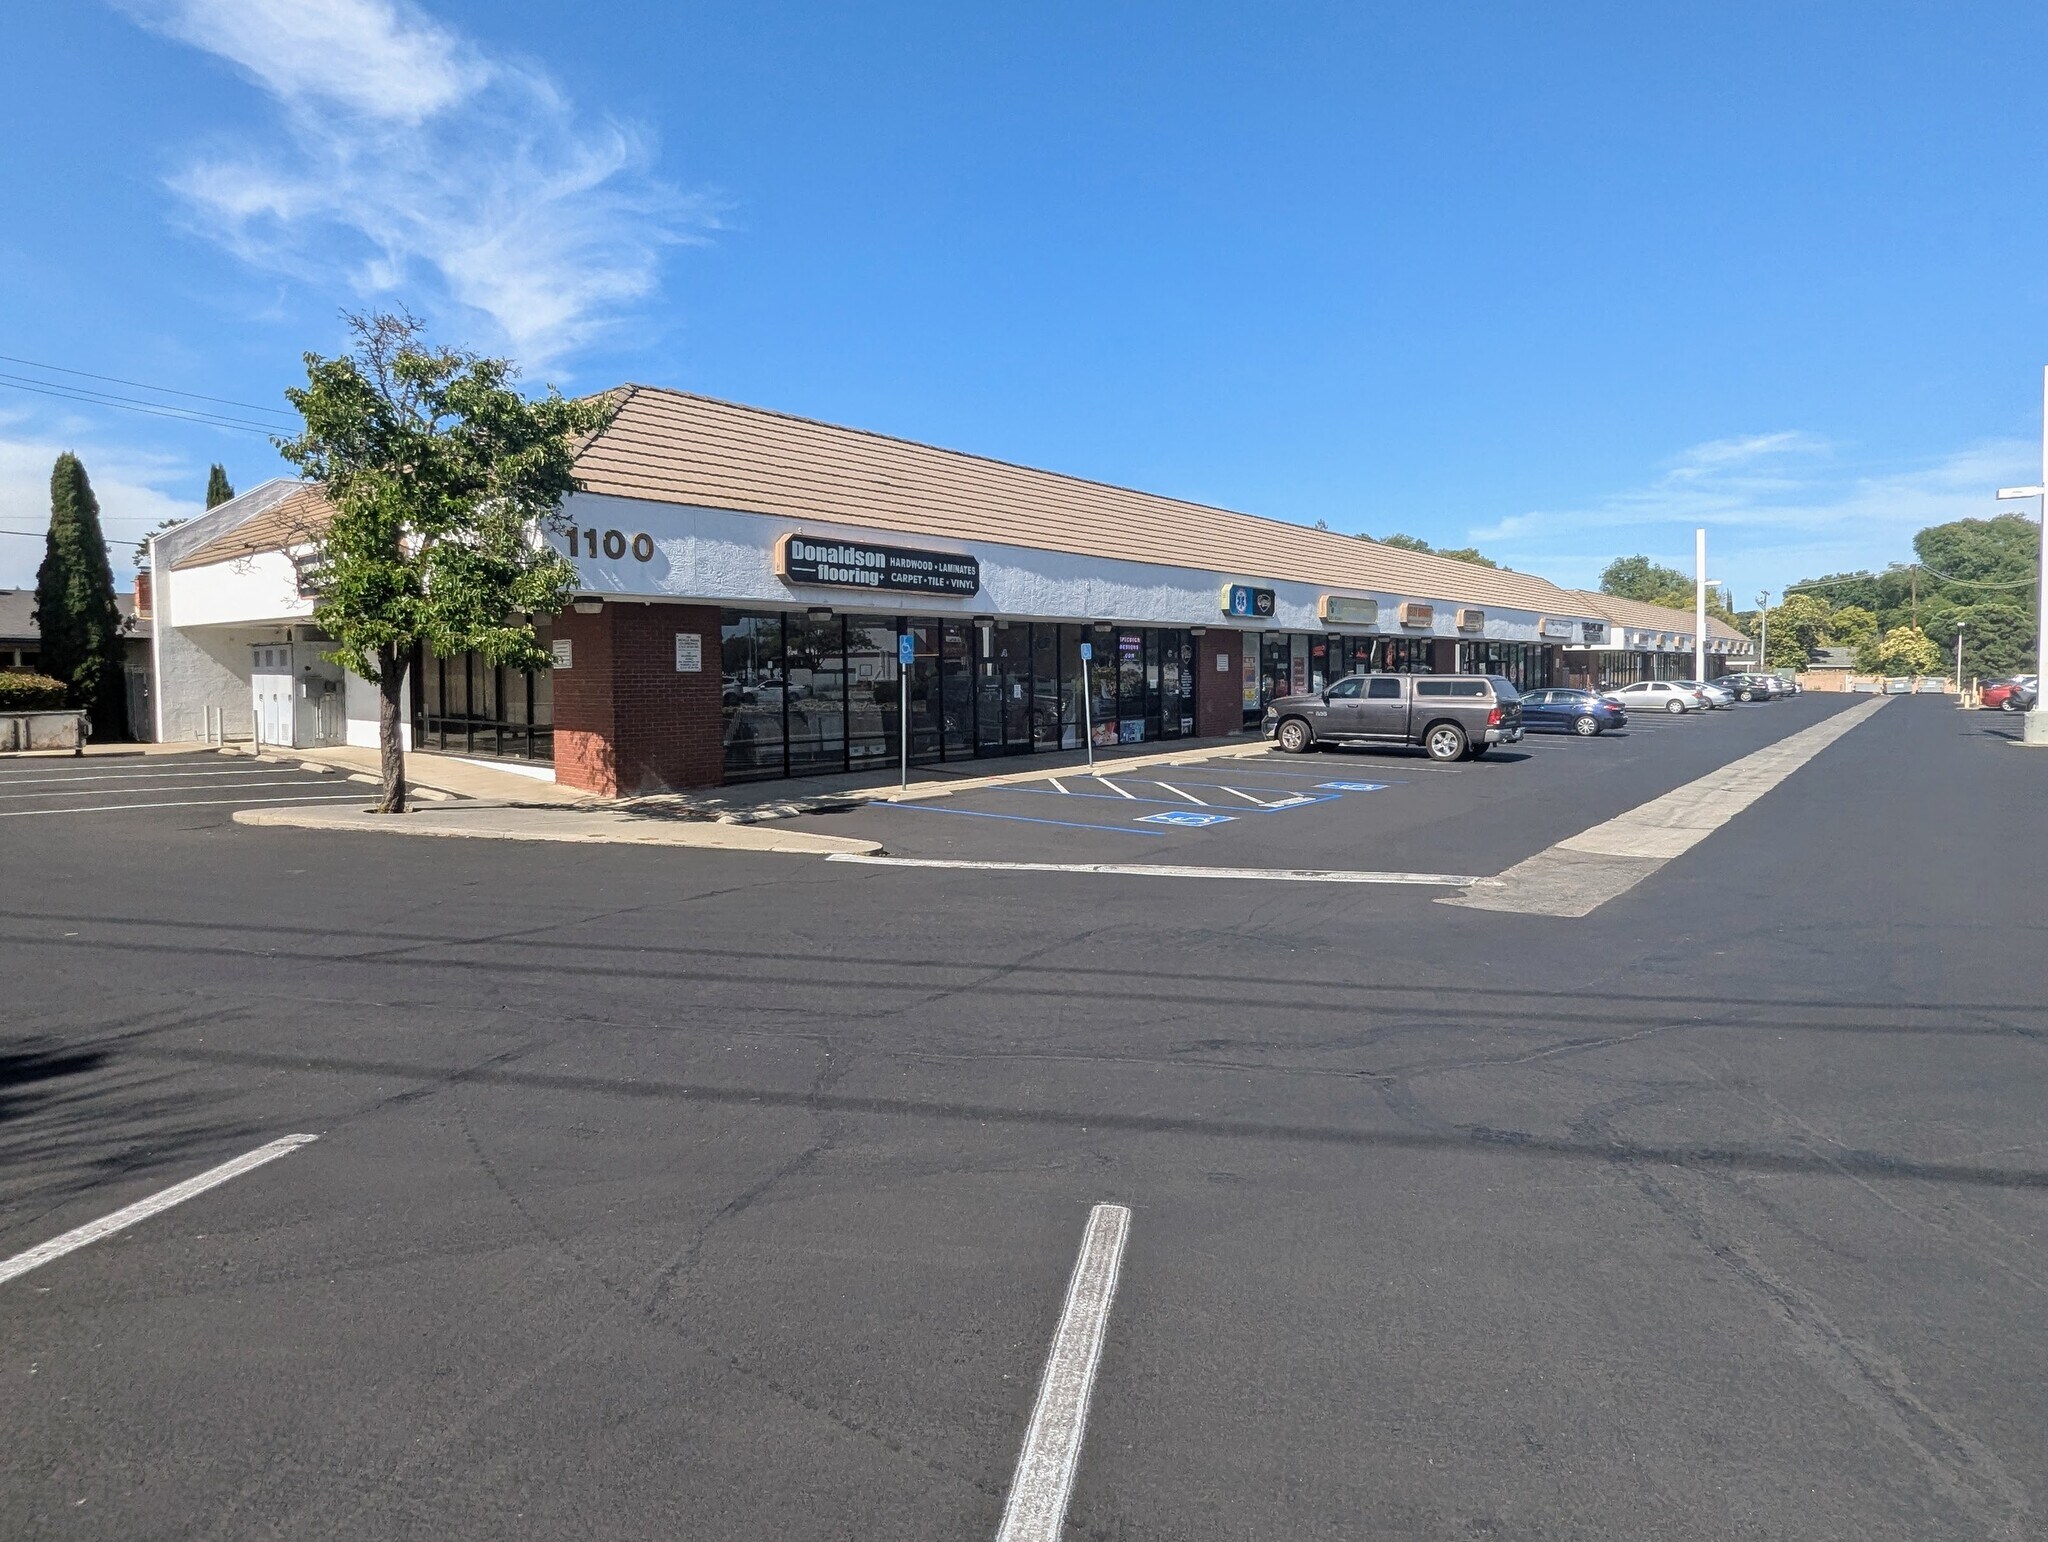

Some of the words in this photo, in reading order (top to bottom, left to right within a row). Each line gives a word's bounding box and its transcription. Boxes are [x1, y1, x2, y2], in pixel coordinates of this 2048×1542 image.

[565, 526, 654, 563] 1100
[791, 540, 886, 569] Donaldson
[890, 557, 933, 571] HARDWOOD
[938, 562, 976, 576] LAMINATES
[890, 572, 923, 585] CARPET
[928, 574, 945, 587] TILE
[951, 579, 975, 590] VINYL
